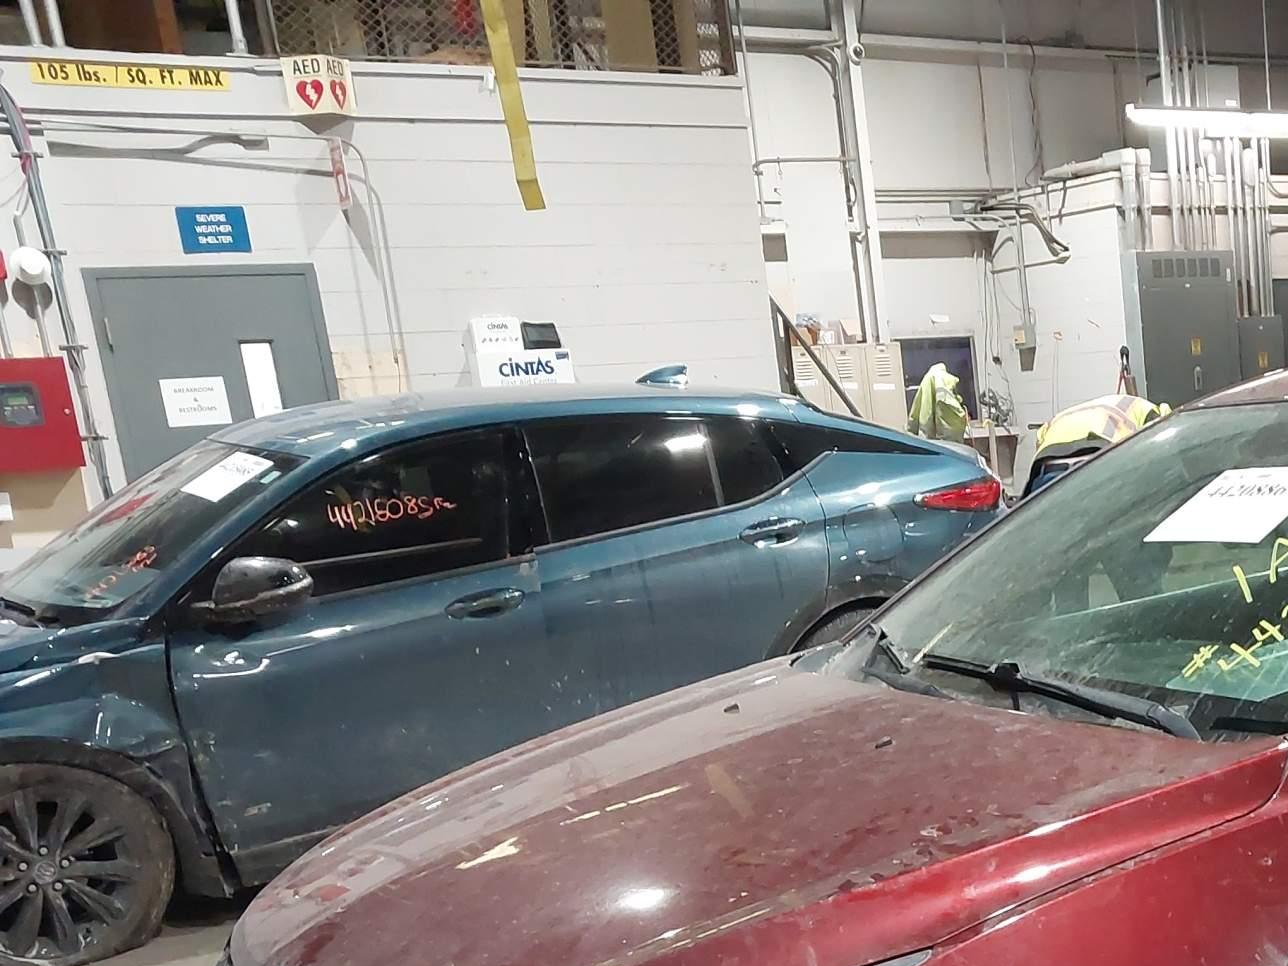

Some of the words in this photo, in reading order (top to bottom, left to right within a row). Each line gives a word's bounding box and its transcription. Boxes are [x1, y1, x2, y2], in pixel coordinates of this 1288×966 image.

[293, 58, 320, 75] AED
[326, 58, 344, 76] AED
[38, 63, 69, 80] 105
[76, 64, 107, 83] lbs.
[127, 67, 153, 84] SQ.
[160, 68, 182, 86] FT.
[188, 69, 224, 87] MAX
[195, 213, 227, 223] SEVERE
[194, 224, 233, 233] WEATHER
[197, 235, 233, 244] SHELTER
